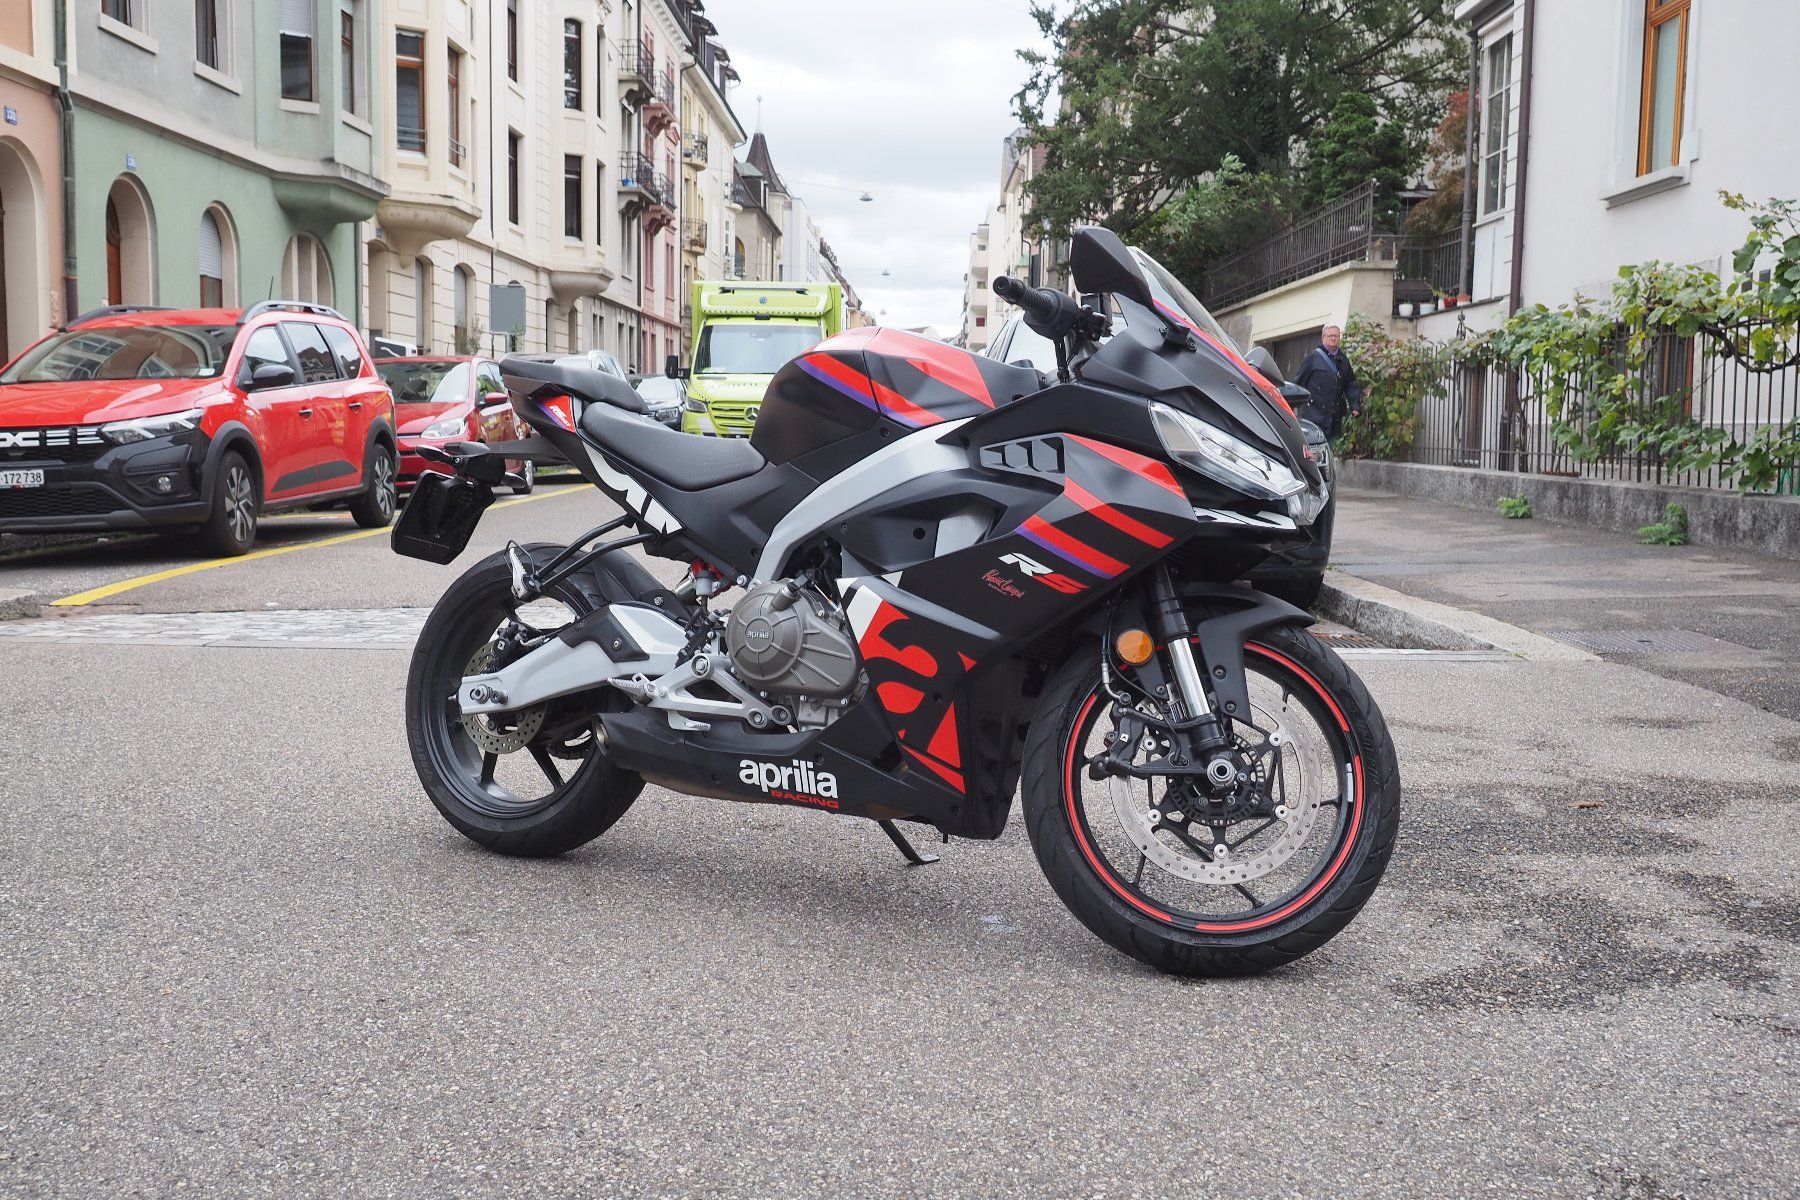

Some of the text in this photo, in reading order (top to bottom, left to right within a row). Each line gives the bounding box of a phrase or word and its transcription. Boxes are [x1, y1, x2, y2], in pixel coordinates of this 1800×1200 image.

[998, 552, 1091, 595] RS
[746, 629, 769, 640] aprilia
[739, 758, 839, 799] aprilia
[770, 789, 839, 809] RACING
